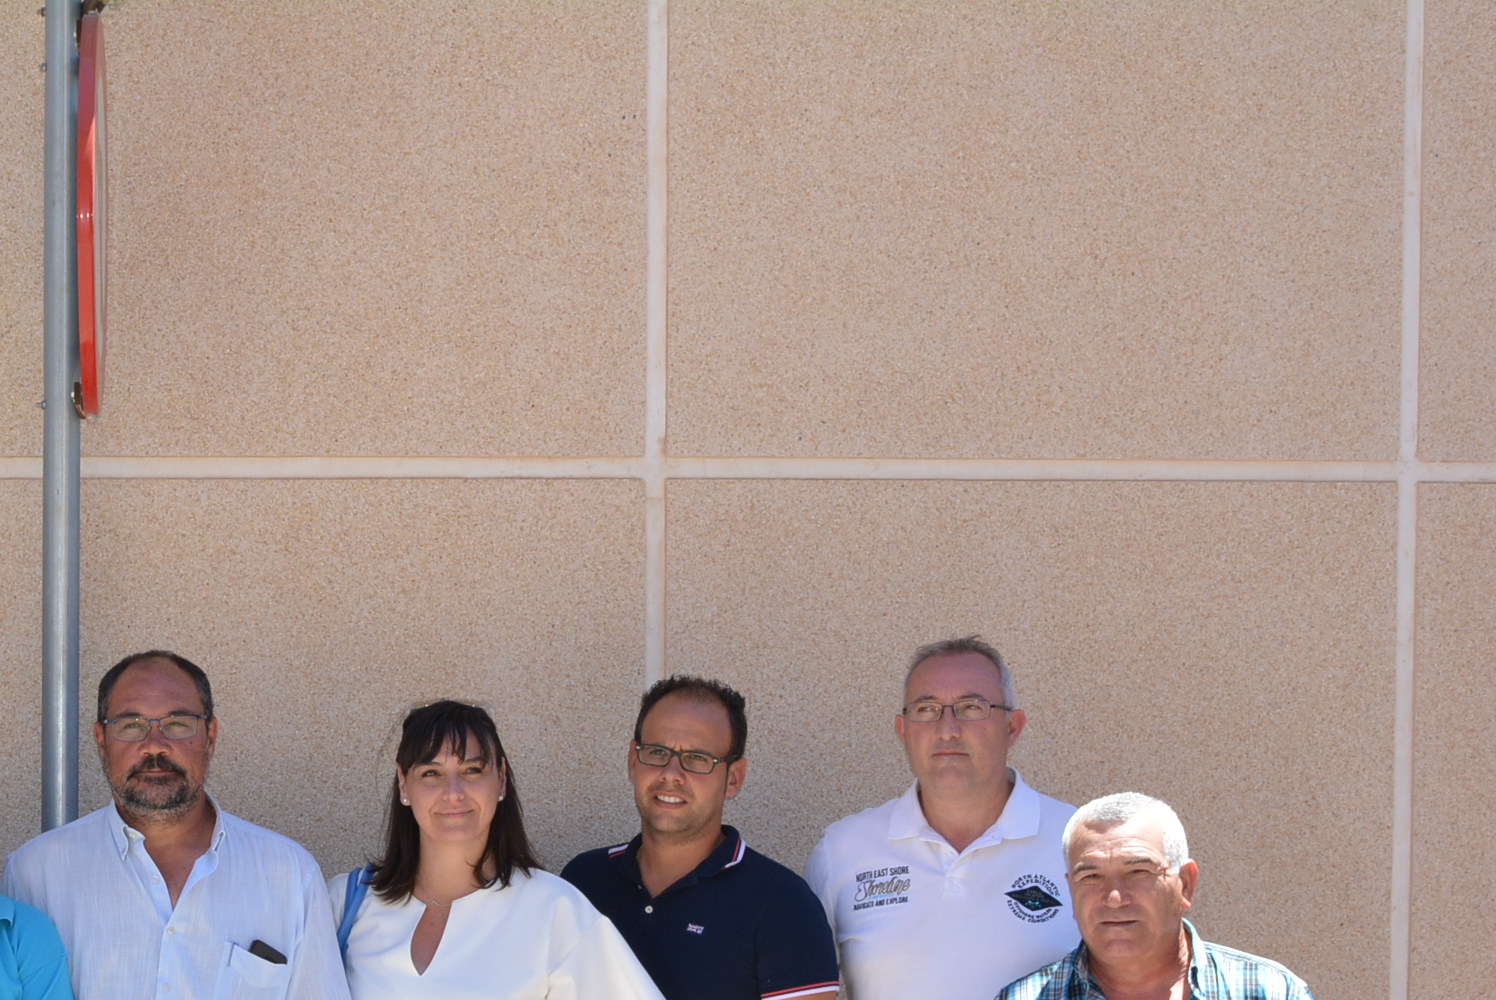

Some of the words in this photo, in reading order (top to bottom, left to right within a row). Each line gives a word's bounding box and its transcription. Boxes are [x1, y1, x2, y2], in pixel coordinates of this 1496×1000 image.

[874, 868, 888, 878] EAST
[889, 866, 909, 876] SHORE
[875, 899, 885, 907] AND
